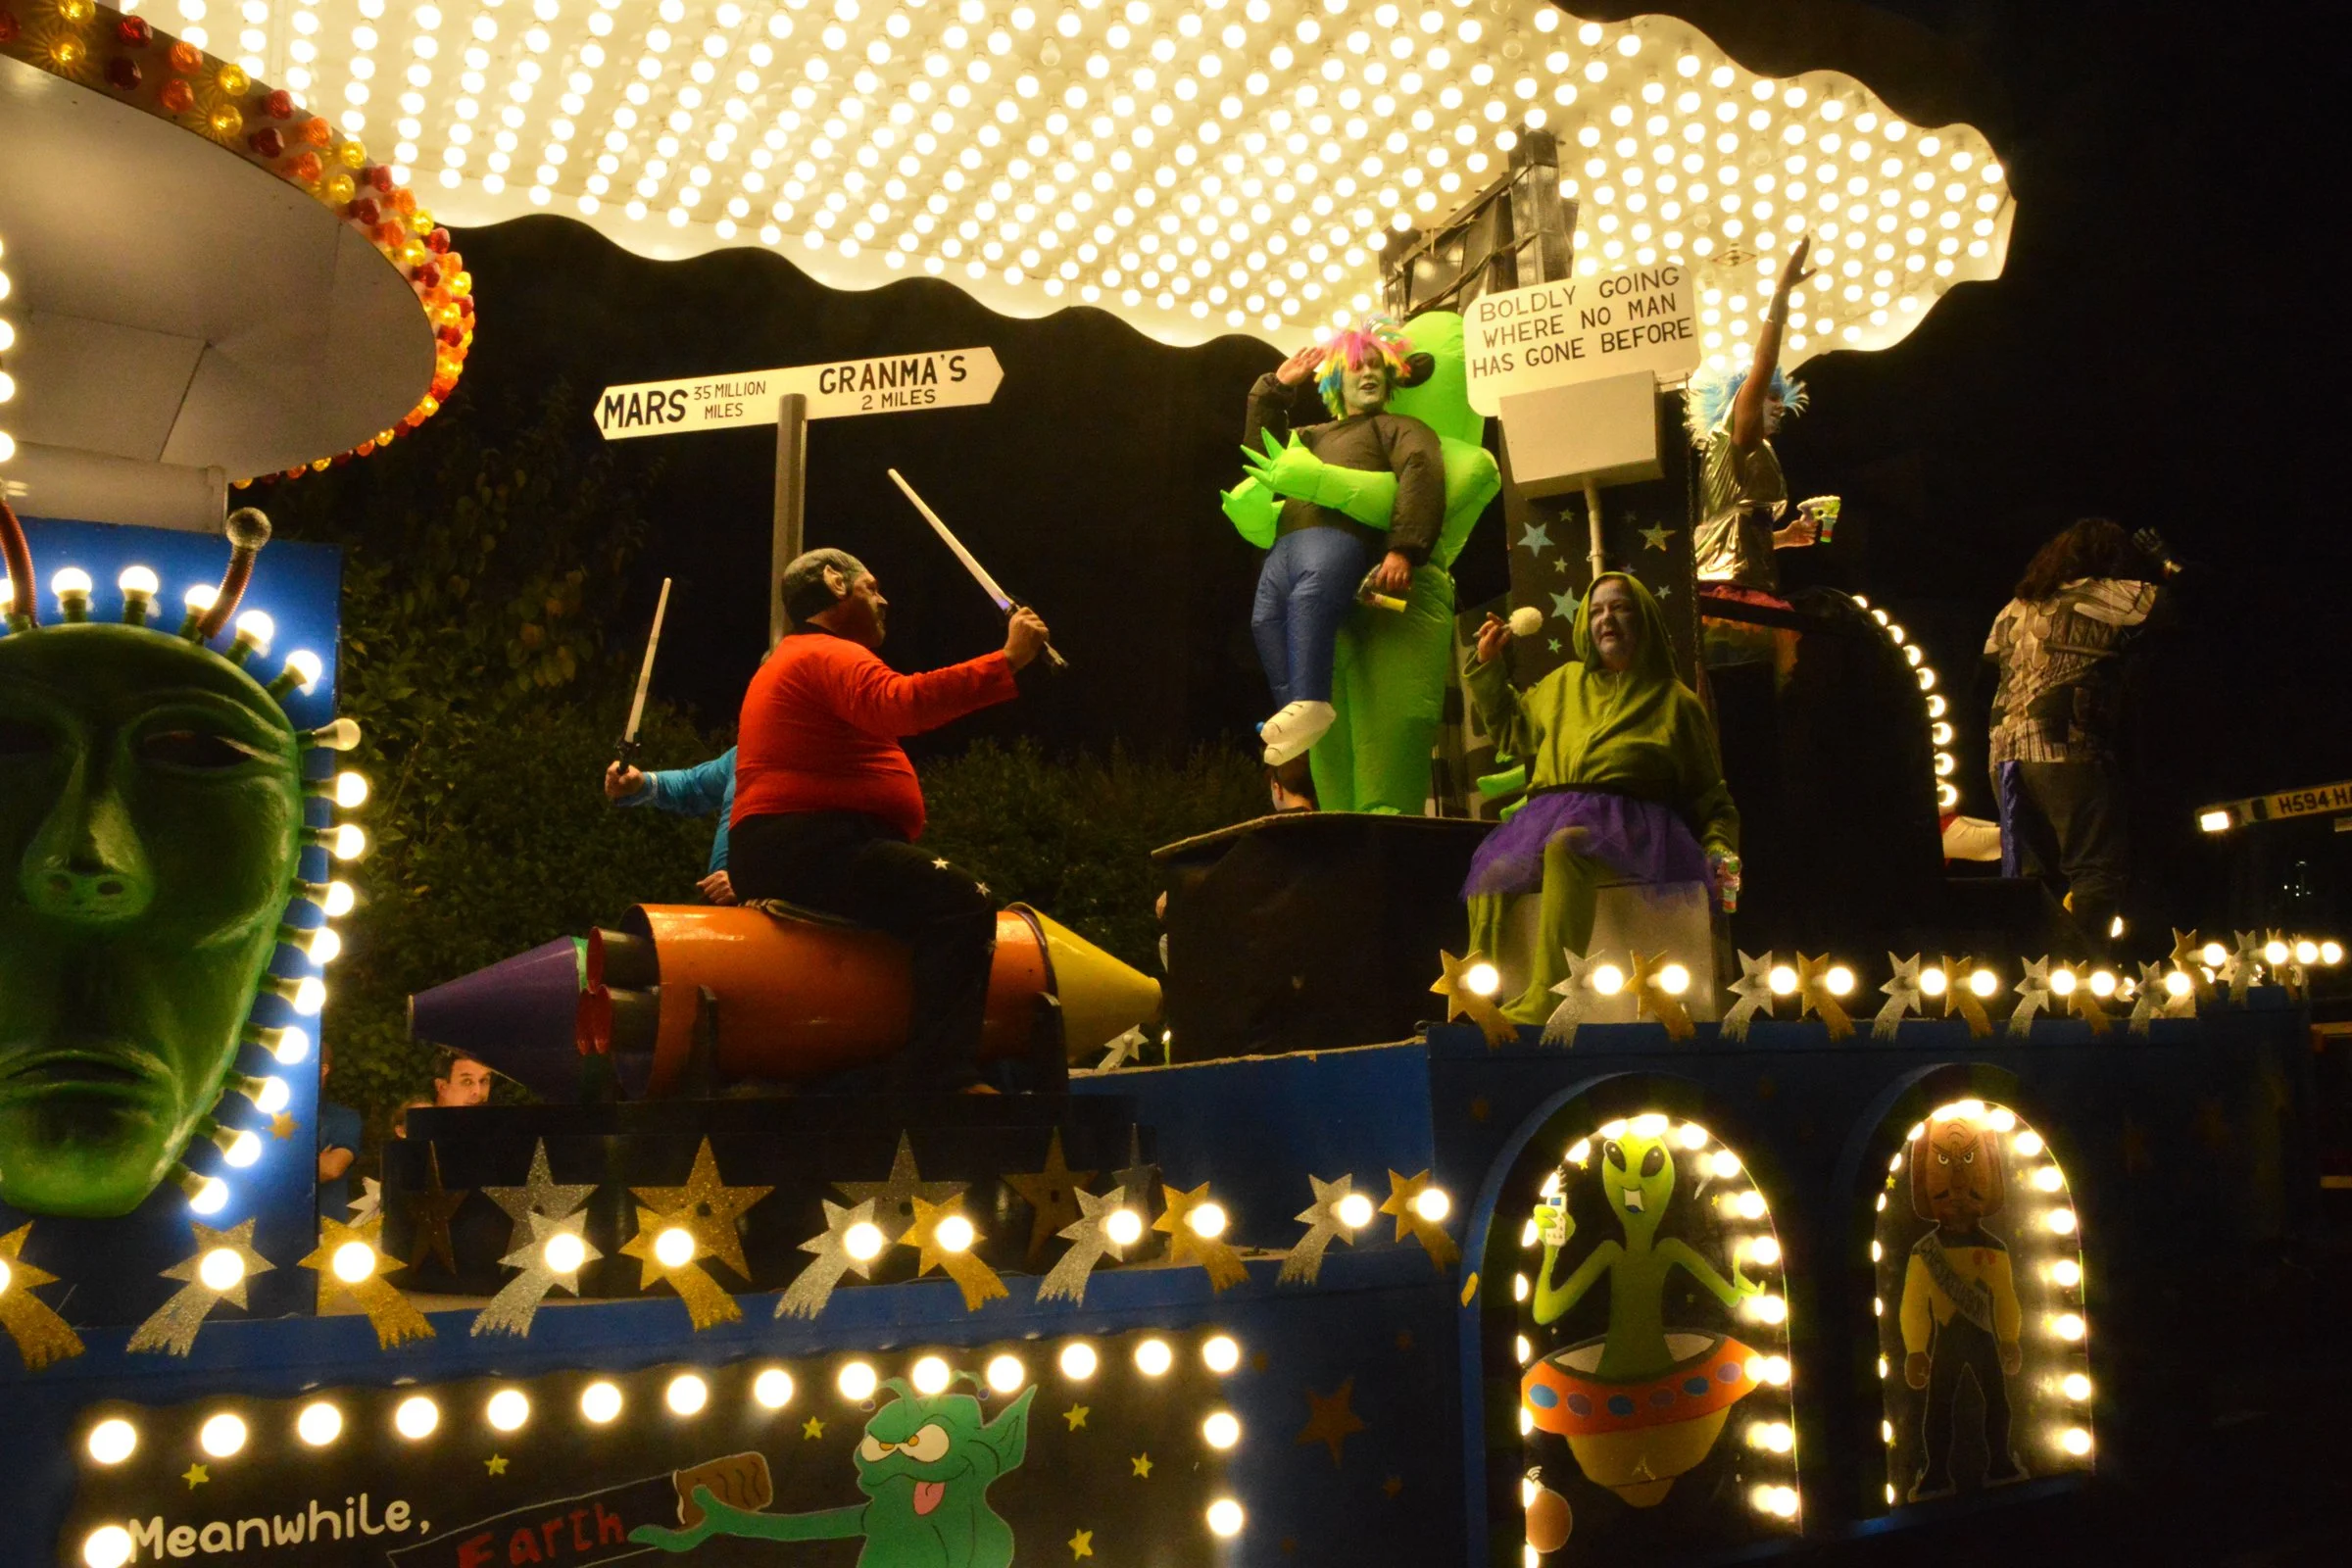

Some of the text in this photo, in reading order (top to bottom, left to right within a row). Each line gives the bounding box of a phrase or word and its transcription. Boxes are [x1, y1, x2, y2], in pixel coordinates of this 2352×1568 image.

[1480, 267, 1680, 322] BOLDLY GOING
[1483, 292, 1677, 349] WHERE NO MAN
[1472, 318, 1693, 378] HAS GONE BEFORE
[694, 380, 766, 400] 35 MILLION
[819, 354, 967, 395] GRANMA'S
[603, 389, 689, 429] MARS
[705, 403, 743, 419] MILES
[861, 389, 936, 411] 2 MILES
[2278, 790, 2329, 814] H594
[128, 1493, 430, 1564] Meanwhile,
